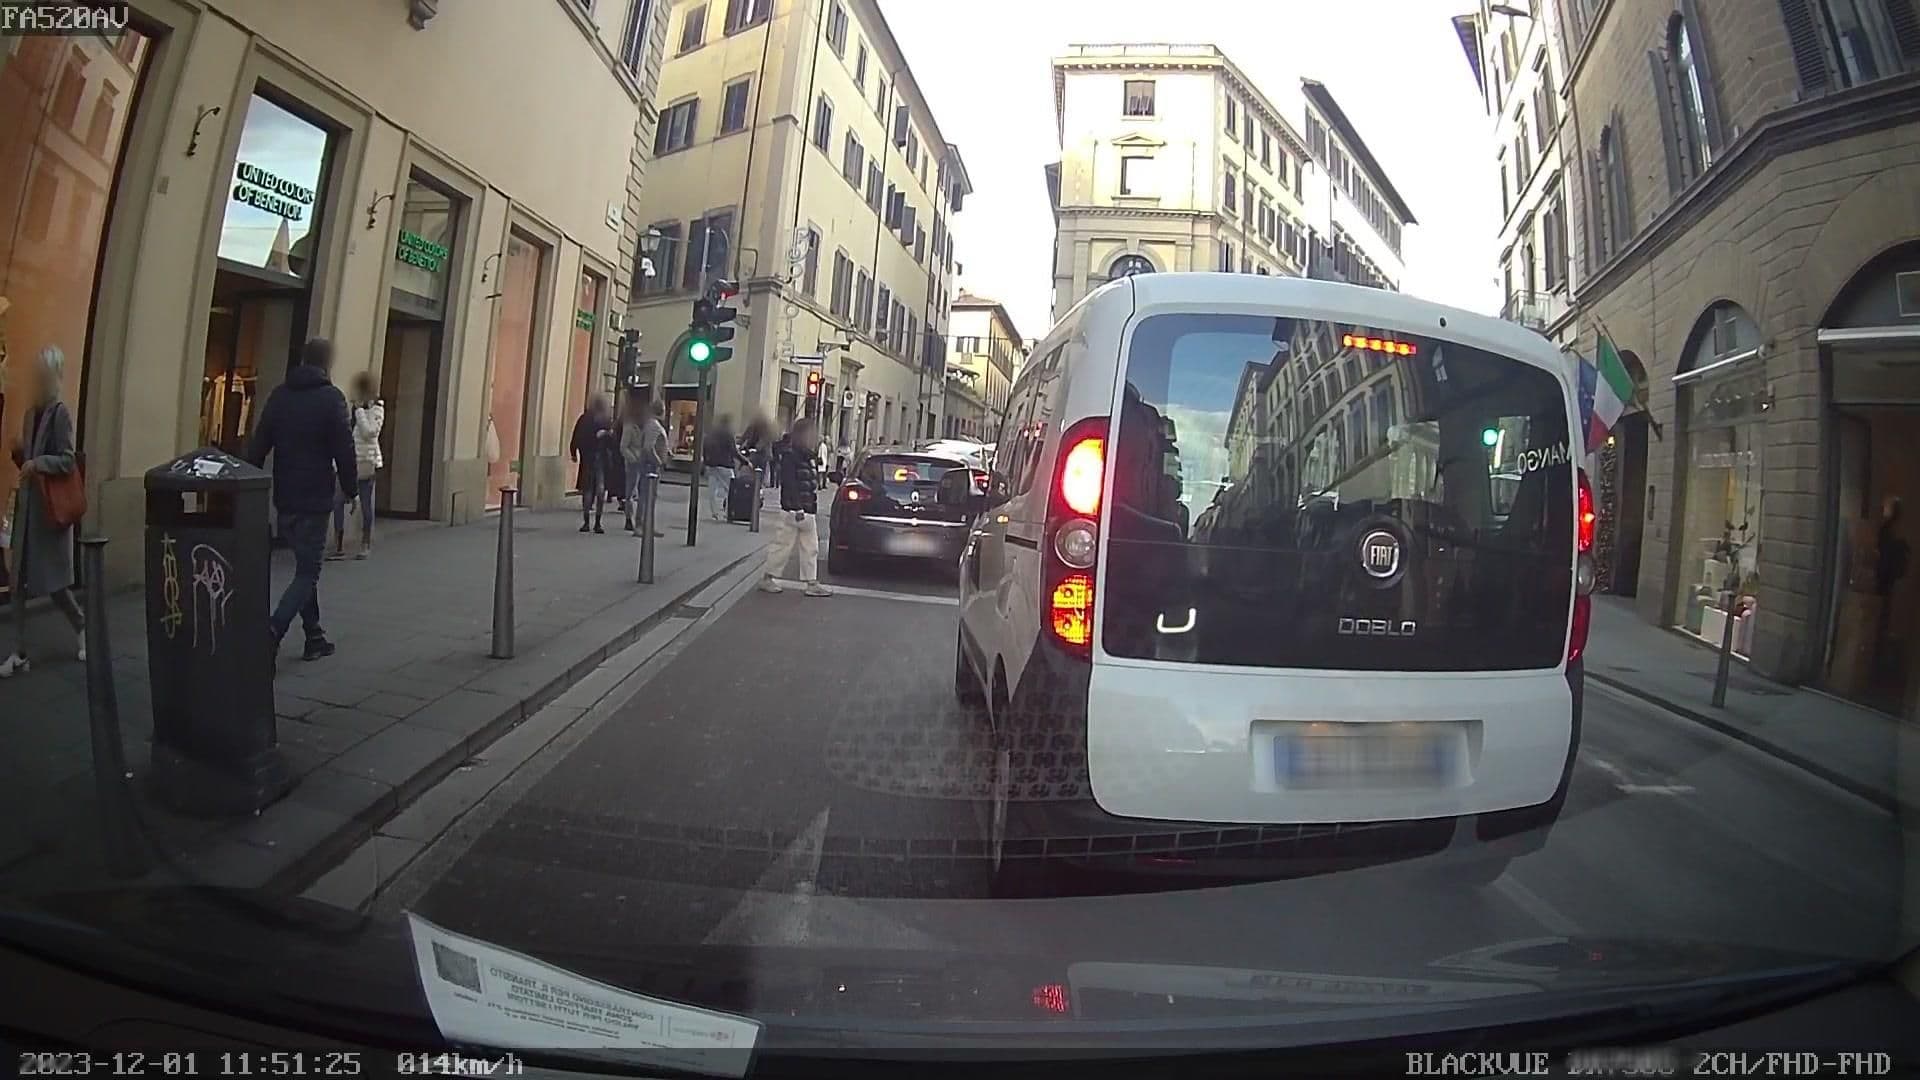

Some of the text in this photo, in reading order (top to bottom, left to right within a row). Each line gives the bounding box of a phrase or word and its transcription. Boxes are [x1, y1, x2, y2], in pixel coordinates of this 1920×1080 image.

[236, 184, 256, 205] OF
[398, 246, 410, 261] OF
[1370, 545, 1393, 566] FIAT
[1338, 617, 1416, 636] DOBLO
